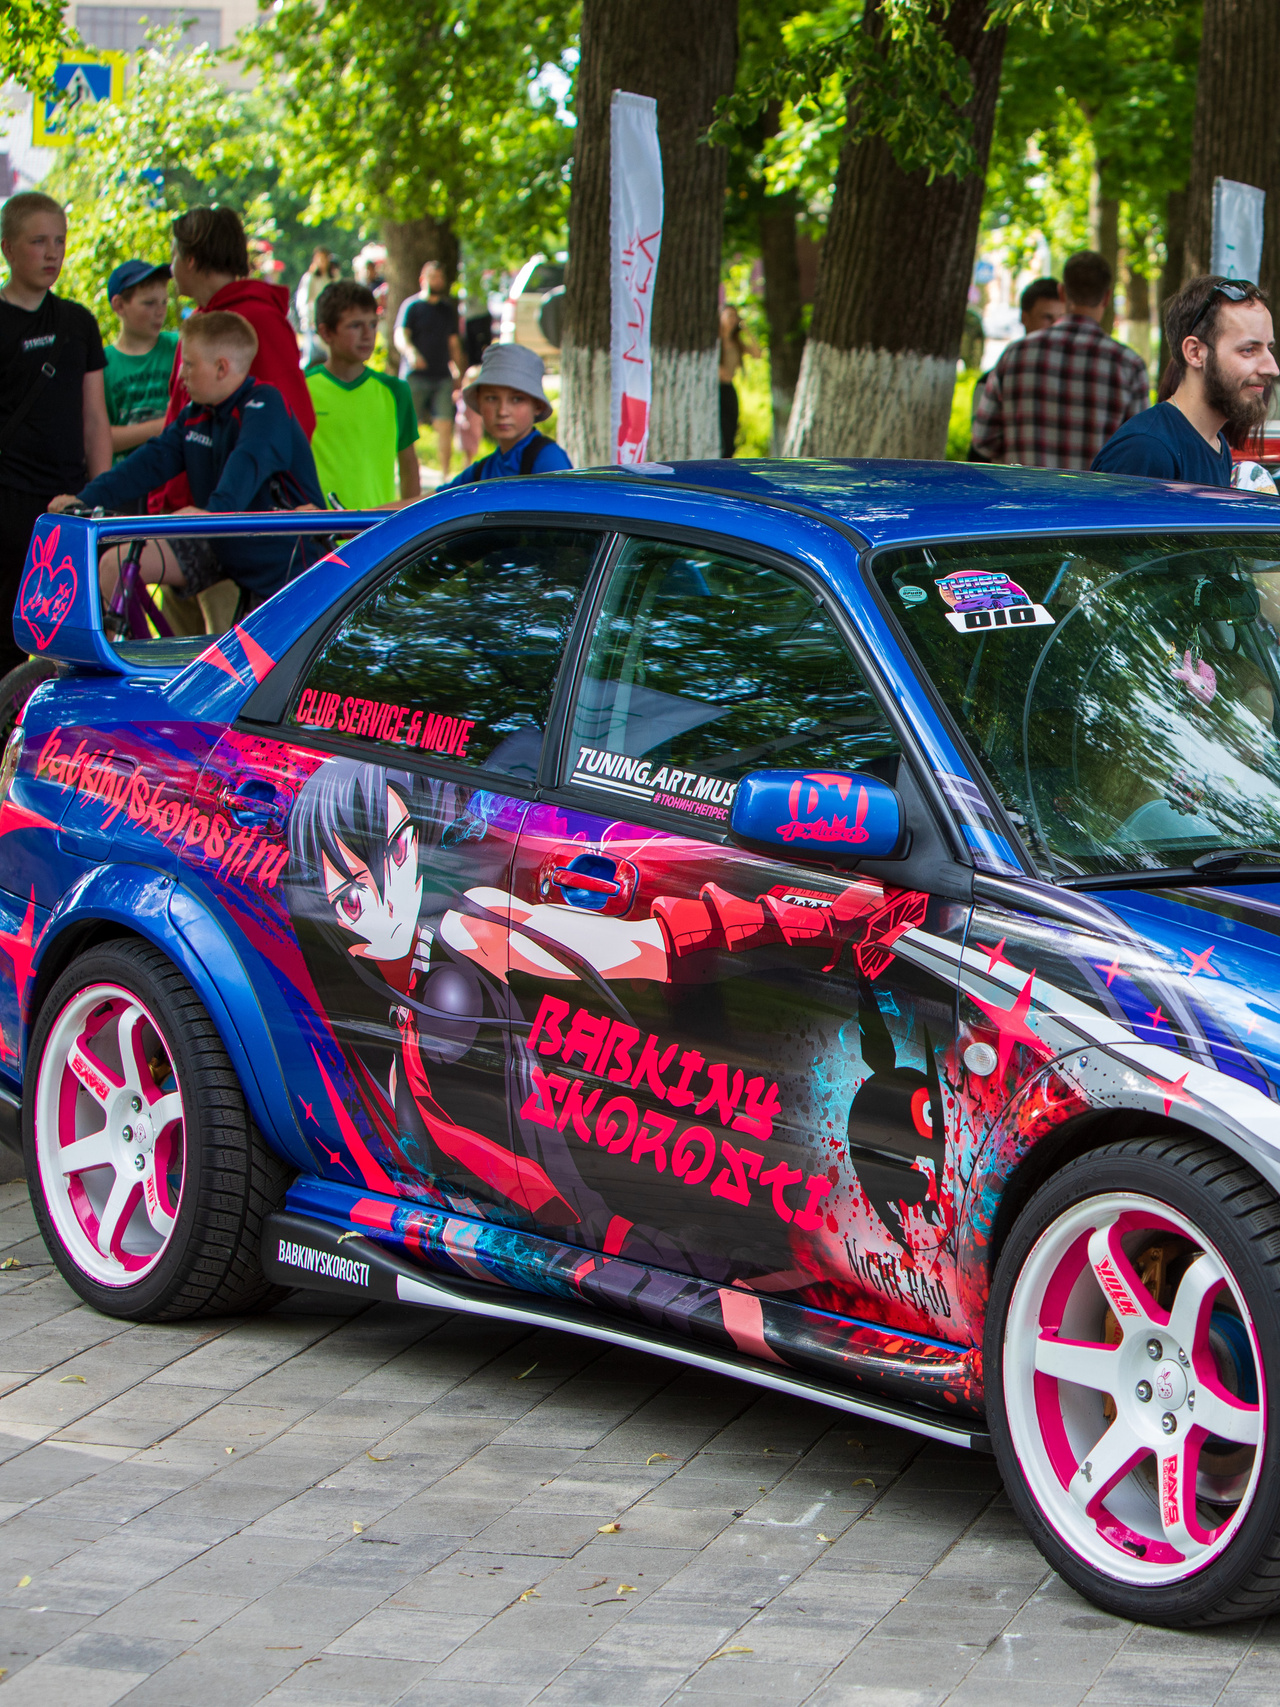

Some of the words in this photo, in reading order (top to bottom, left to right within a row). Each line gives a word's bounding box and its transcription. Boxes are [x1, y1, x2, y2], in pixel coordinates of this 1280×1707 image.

[936, 574, 1008, 591] TURBO
[963, 607, 1037, 630] 010
[296, 688, 342, 729] CLUB
[337, 696, 410, 743] SERVICE
[406, 711, 424, 746] &
[419, 712, 475, 758] MOVE
[71, 1057, 108, 1101] RAYS
[526, 993, 782, 1141] BABKINY
[520, 1066, 833, 1231] SKOROSTI
[278, 1239, 370, 1288] BABKINYSKOROSTI
[845, 1238, 904, 1305] NIGHT
[904, 1264, 951, 1318] RAID
[1168, 1454, 1180, 1524] RAYS
